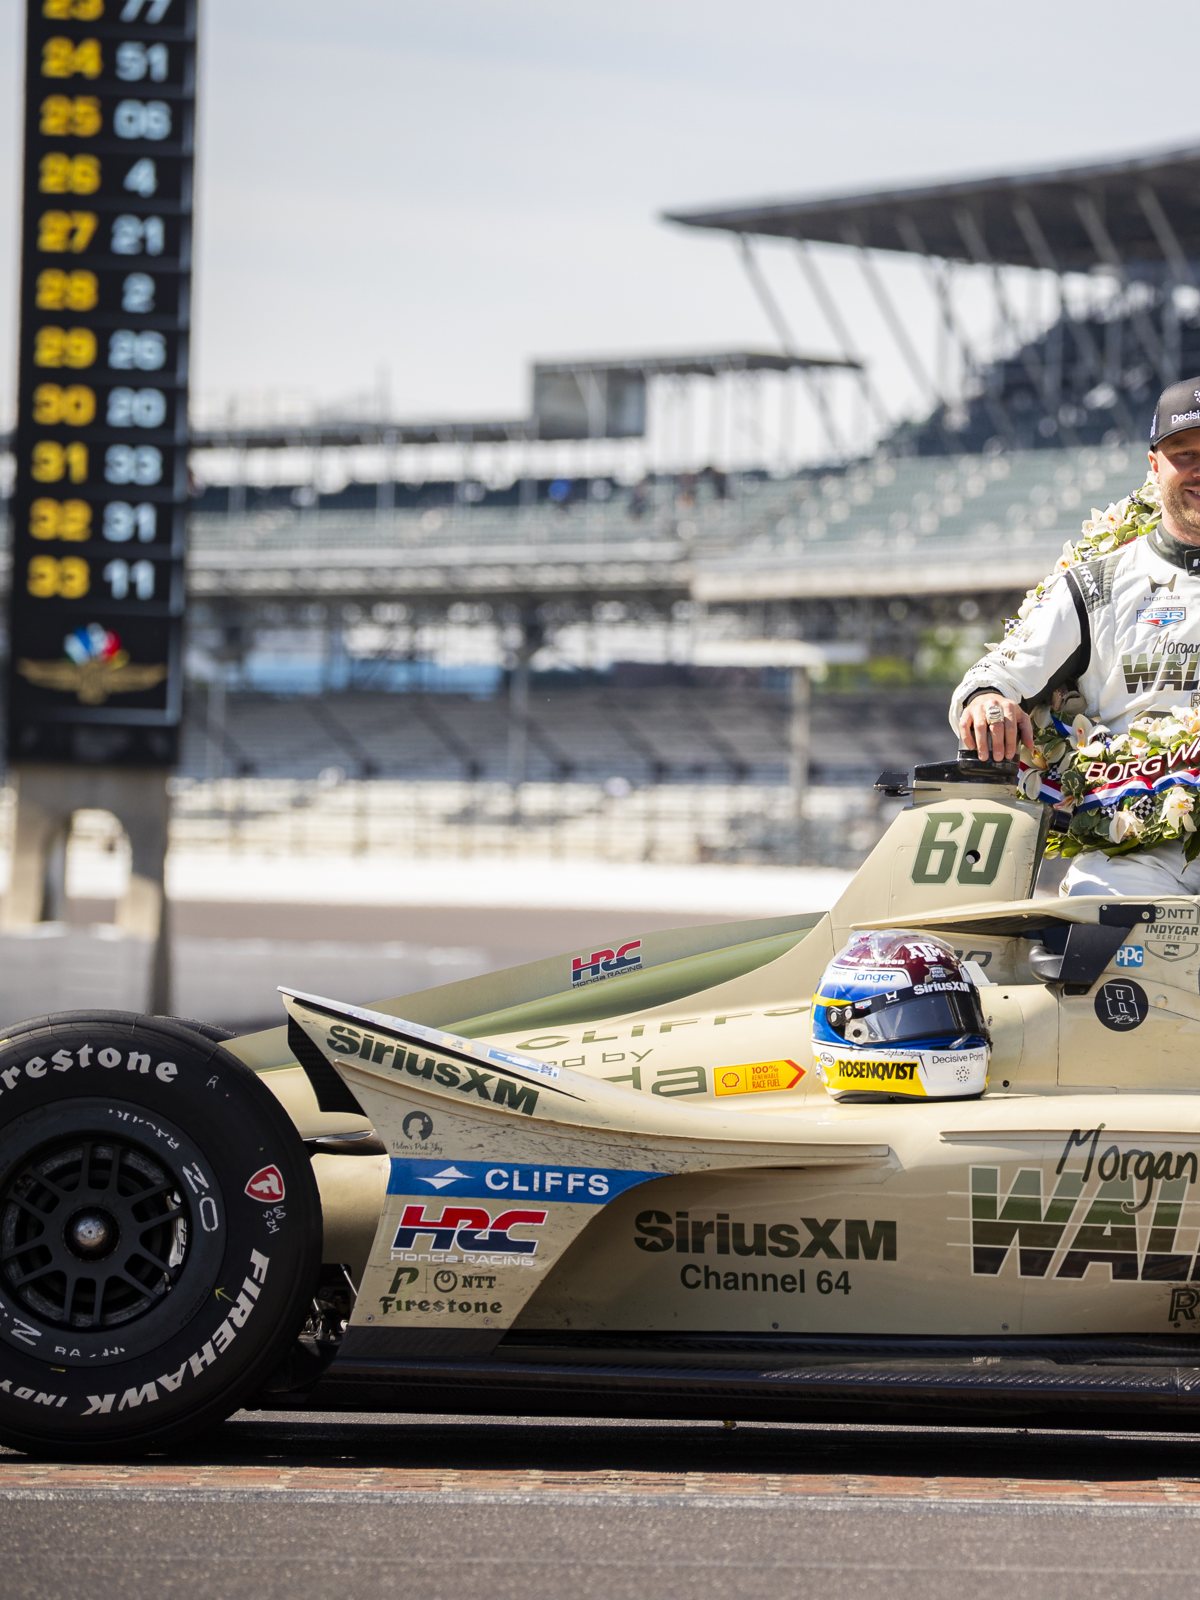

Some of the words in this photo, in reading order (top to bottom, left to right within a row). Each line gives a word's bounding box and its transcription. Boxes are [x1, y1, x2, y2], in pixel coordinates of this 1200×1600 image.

[123, 157, 158, 198] 4
[37, 210, 98, 253] 27
[111, 214, 165, 256] 21
[122, 271, 155, 313] 2
[32, 383, 96, 427] 30
[31, 441, 89, 483] 31
[103, 558, 155, 600] 11
[1080, 565, 1099, 597] HRX
[1139, 611, 1184, 619] MSR
[911, 812, 1013, 887] 60
[1168, 908, 1195, 920] NTT
[1145, 924, 1199, 936] INDYCAR
[571, 939, 642, 983] HRC
[1116, 946, 1144, 967] PPG
[573, 975, 606, 988] Honda
[607, 963, 643, 979] RACING
[913, 980, 971, 996] SiriusXM
[325, 1025, 540, 1117] SiriusXM
[751, 1064, 779, 1075] 100%
[838, 1060, 918, 1081] ROSENQVIST
[931, 1054, 967, 1065] Decisive
[751, 1079, 767, 1089] RACE
[767, 1079, 781, 1088] FUEL
[485, 1168, 610, 1196] CLIFFS
[1055, 1122, 1199, 1215] Morgan
[390, 1203, 549, 1256] HRC
[634, 1210, 897, 1261] SiriusXM
[389, 1251, 459, 1264] Honda
[463, 1252, 535, 1267] RACING
[461, 1275, 497, 1289] NTT
[680, 1264, 806, 1293] Channel
[816, 1270, 852, 1295] 64
[379, 1296, 503, 1314] Firestone
[80, 1248, 270, 1417] FIREHAWK
